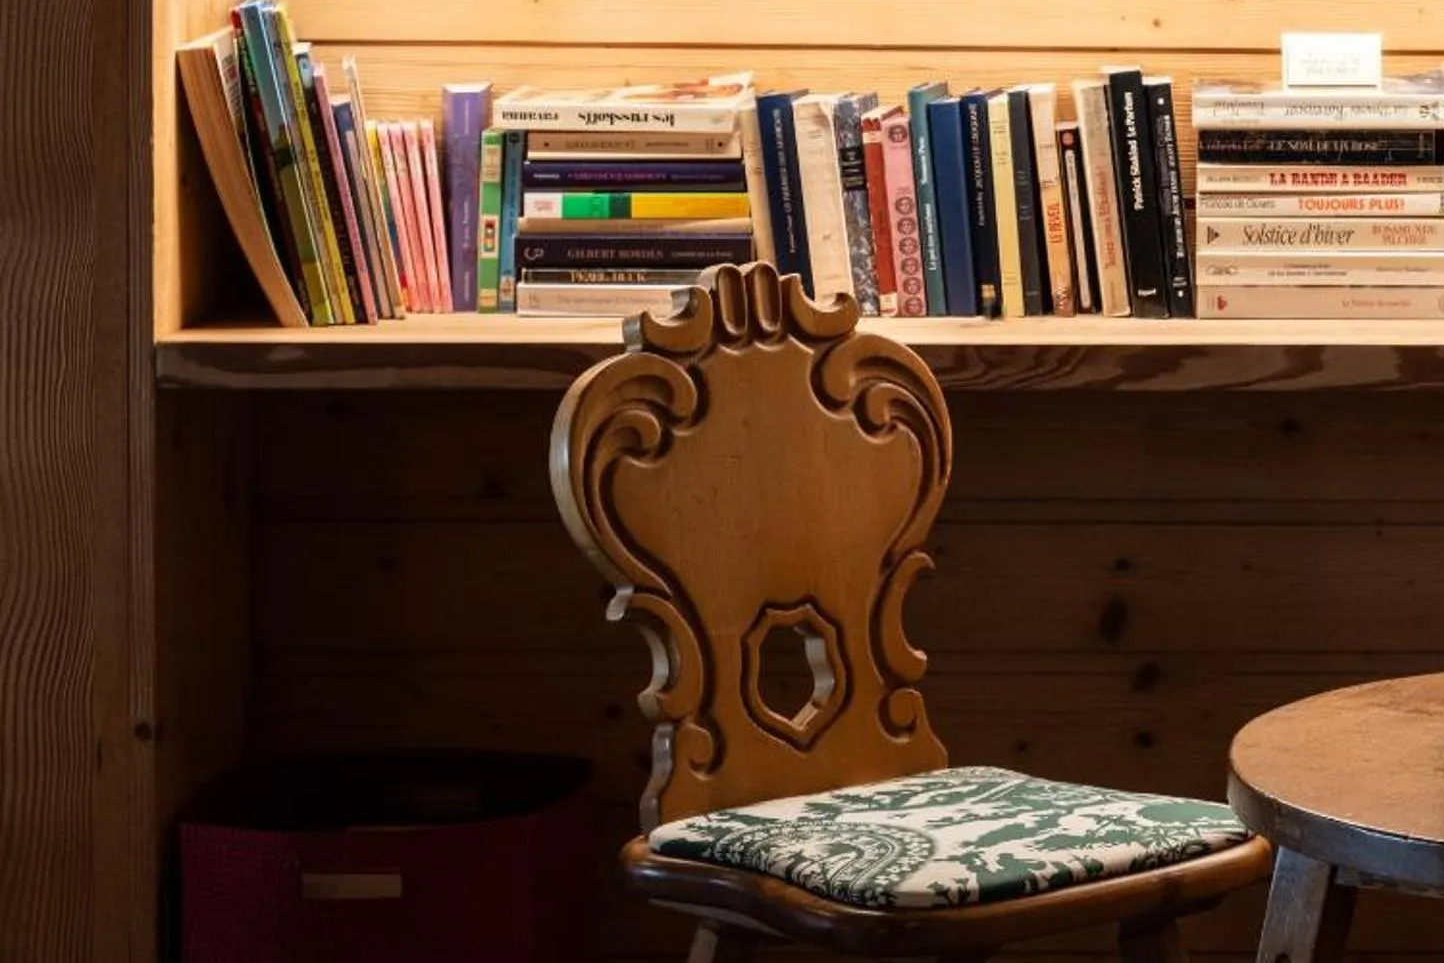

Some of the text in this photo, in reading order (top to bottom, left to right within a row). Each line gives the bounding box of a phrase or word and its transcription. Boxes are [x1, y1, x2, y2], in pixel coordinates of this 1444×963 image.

[1269, 172, 1286, 186] LA
[1291, 172, 1338, 186] BANDE
[1353, 172, 1408, 186] BAADER
[1130, 176, 1144, 210] Patrick
[1297, 198, 1365, 211] TOUJOURS
[1242, 223, 1297, 247] Solstice
[1300, 223, 1356, 245] d'hiver
